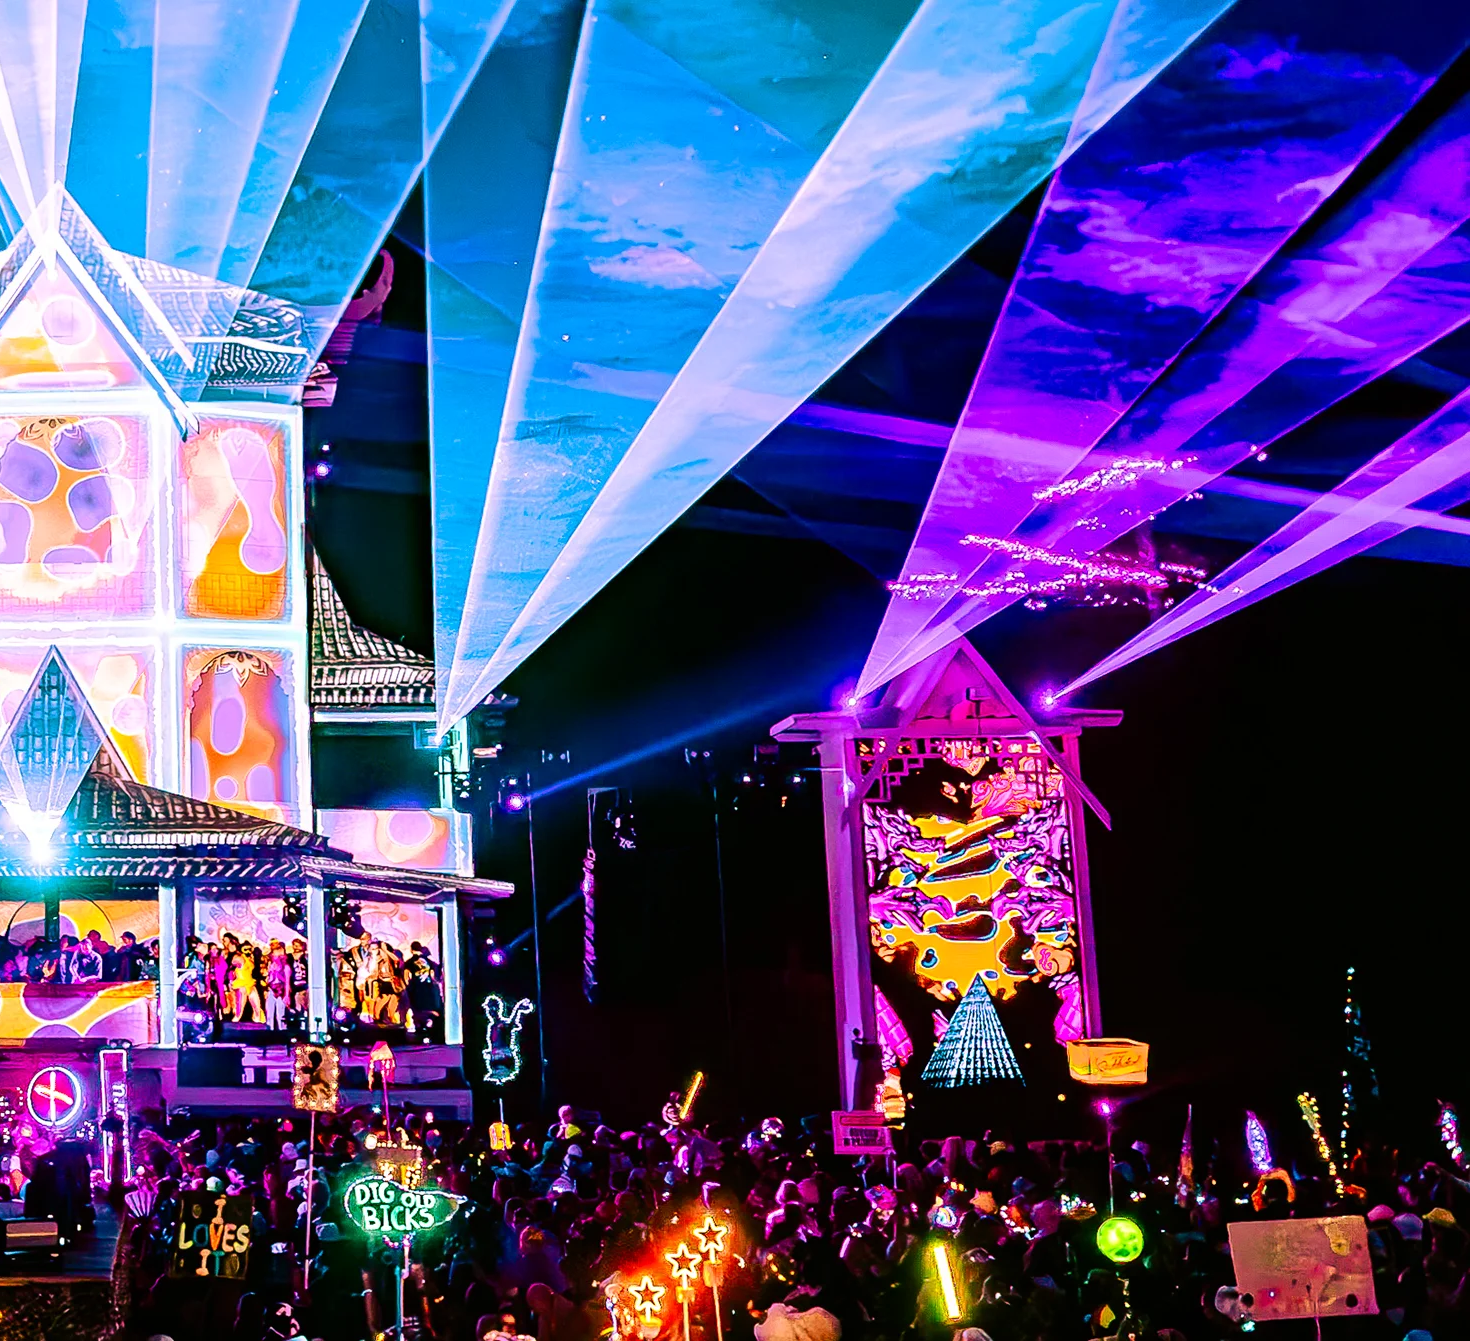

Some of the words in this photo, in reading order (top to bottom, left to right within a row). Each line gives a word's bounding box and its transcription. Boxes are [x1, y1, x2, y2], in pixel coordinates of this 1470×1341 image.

[354, 1182, 395, 1205] DIG
[400, 1192, 436, 1209] OLD
[362, 1204, 435, 1231] BICKS
[179, 1222, 250, 1253] LOVES
[195, 1248, 226, 1277] IT
